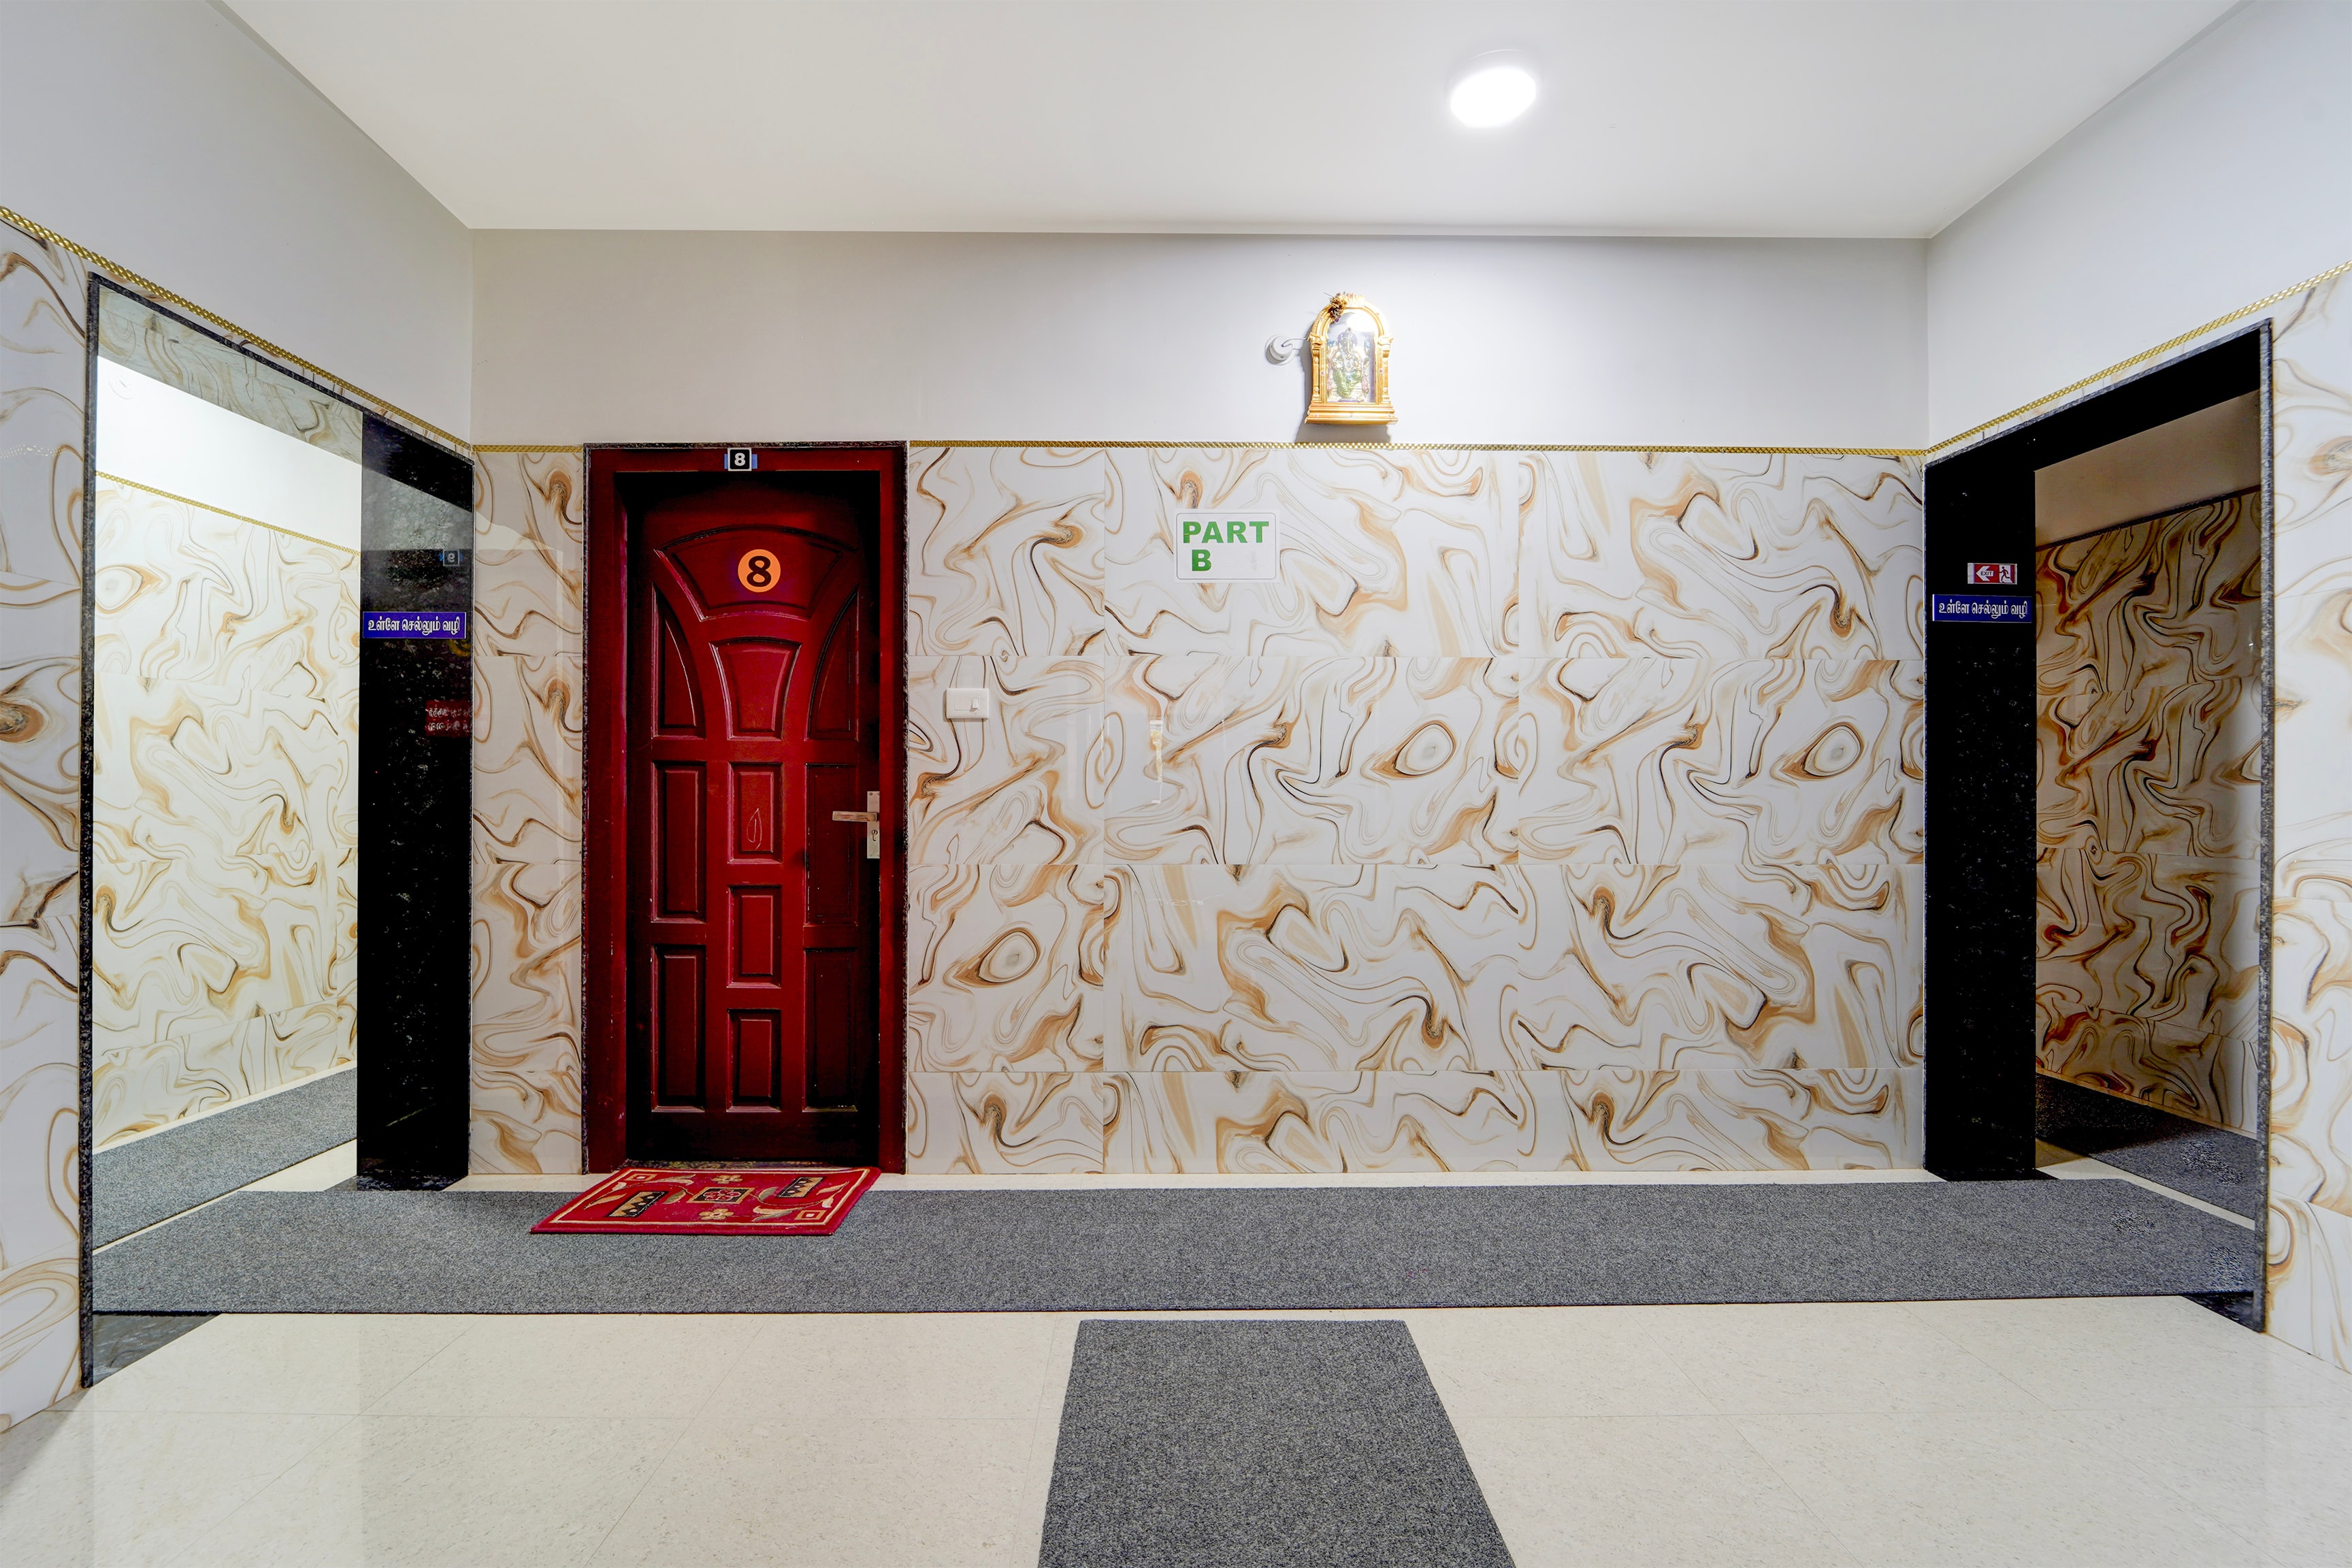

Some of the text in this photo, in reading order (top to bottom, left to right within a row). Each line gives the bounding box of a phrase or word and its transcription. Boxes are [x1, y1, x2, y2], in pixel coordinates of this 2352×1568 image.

[734, 453, 746, 466] 8
[1183, 521, 1269, 543] PART
[1192, 549, 1212, 571] B
[747, 555, 772, 587] 8
[1939, 599, 2028, 619] உள்ளே செல்லும் வழி
[368, 615, 460, 636] உள்ளே செல்லும் வழி
